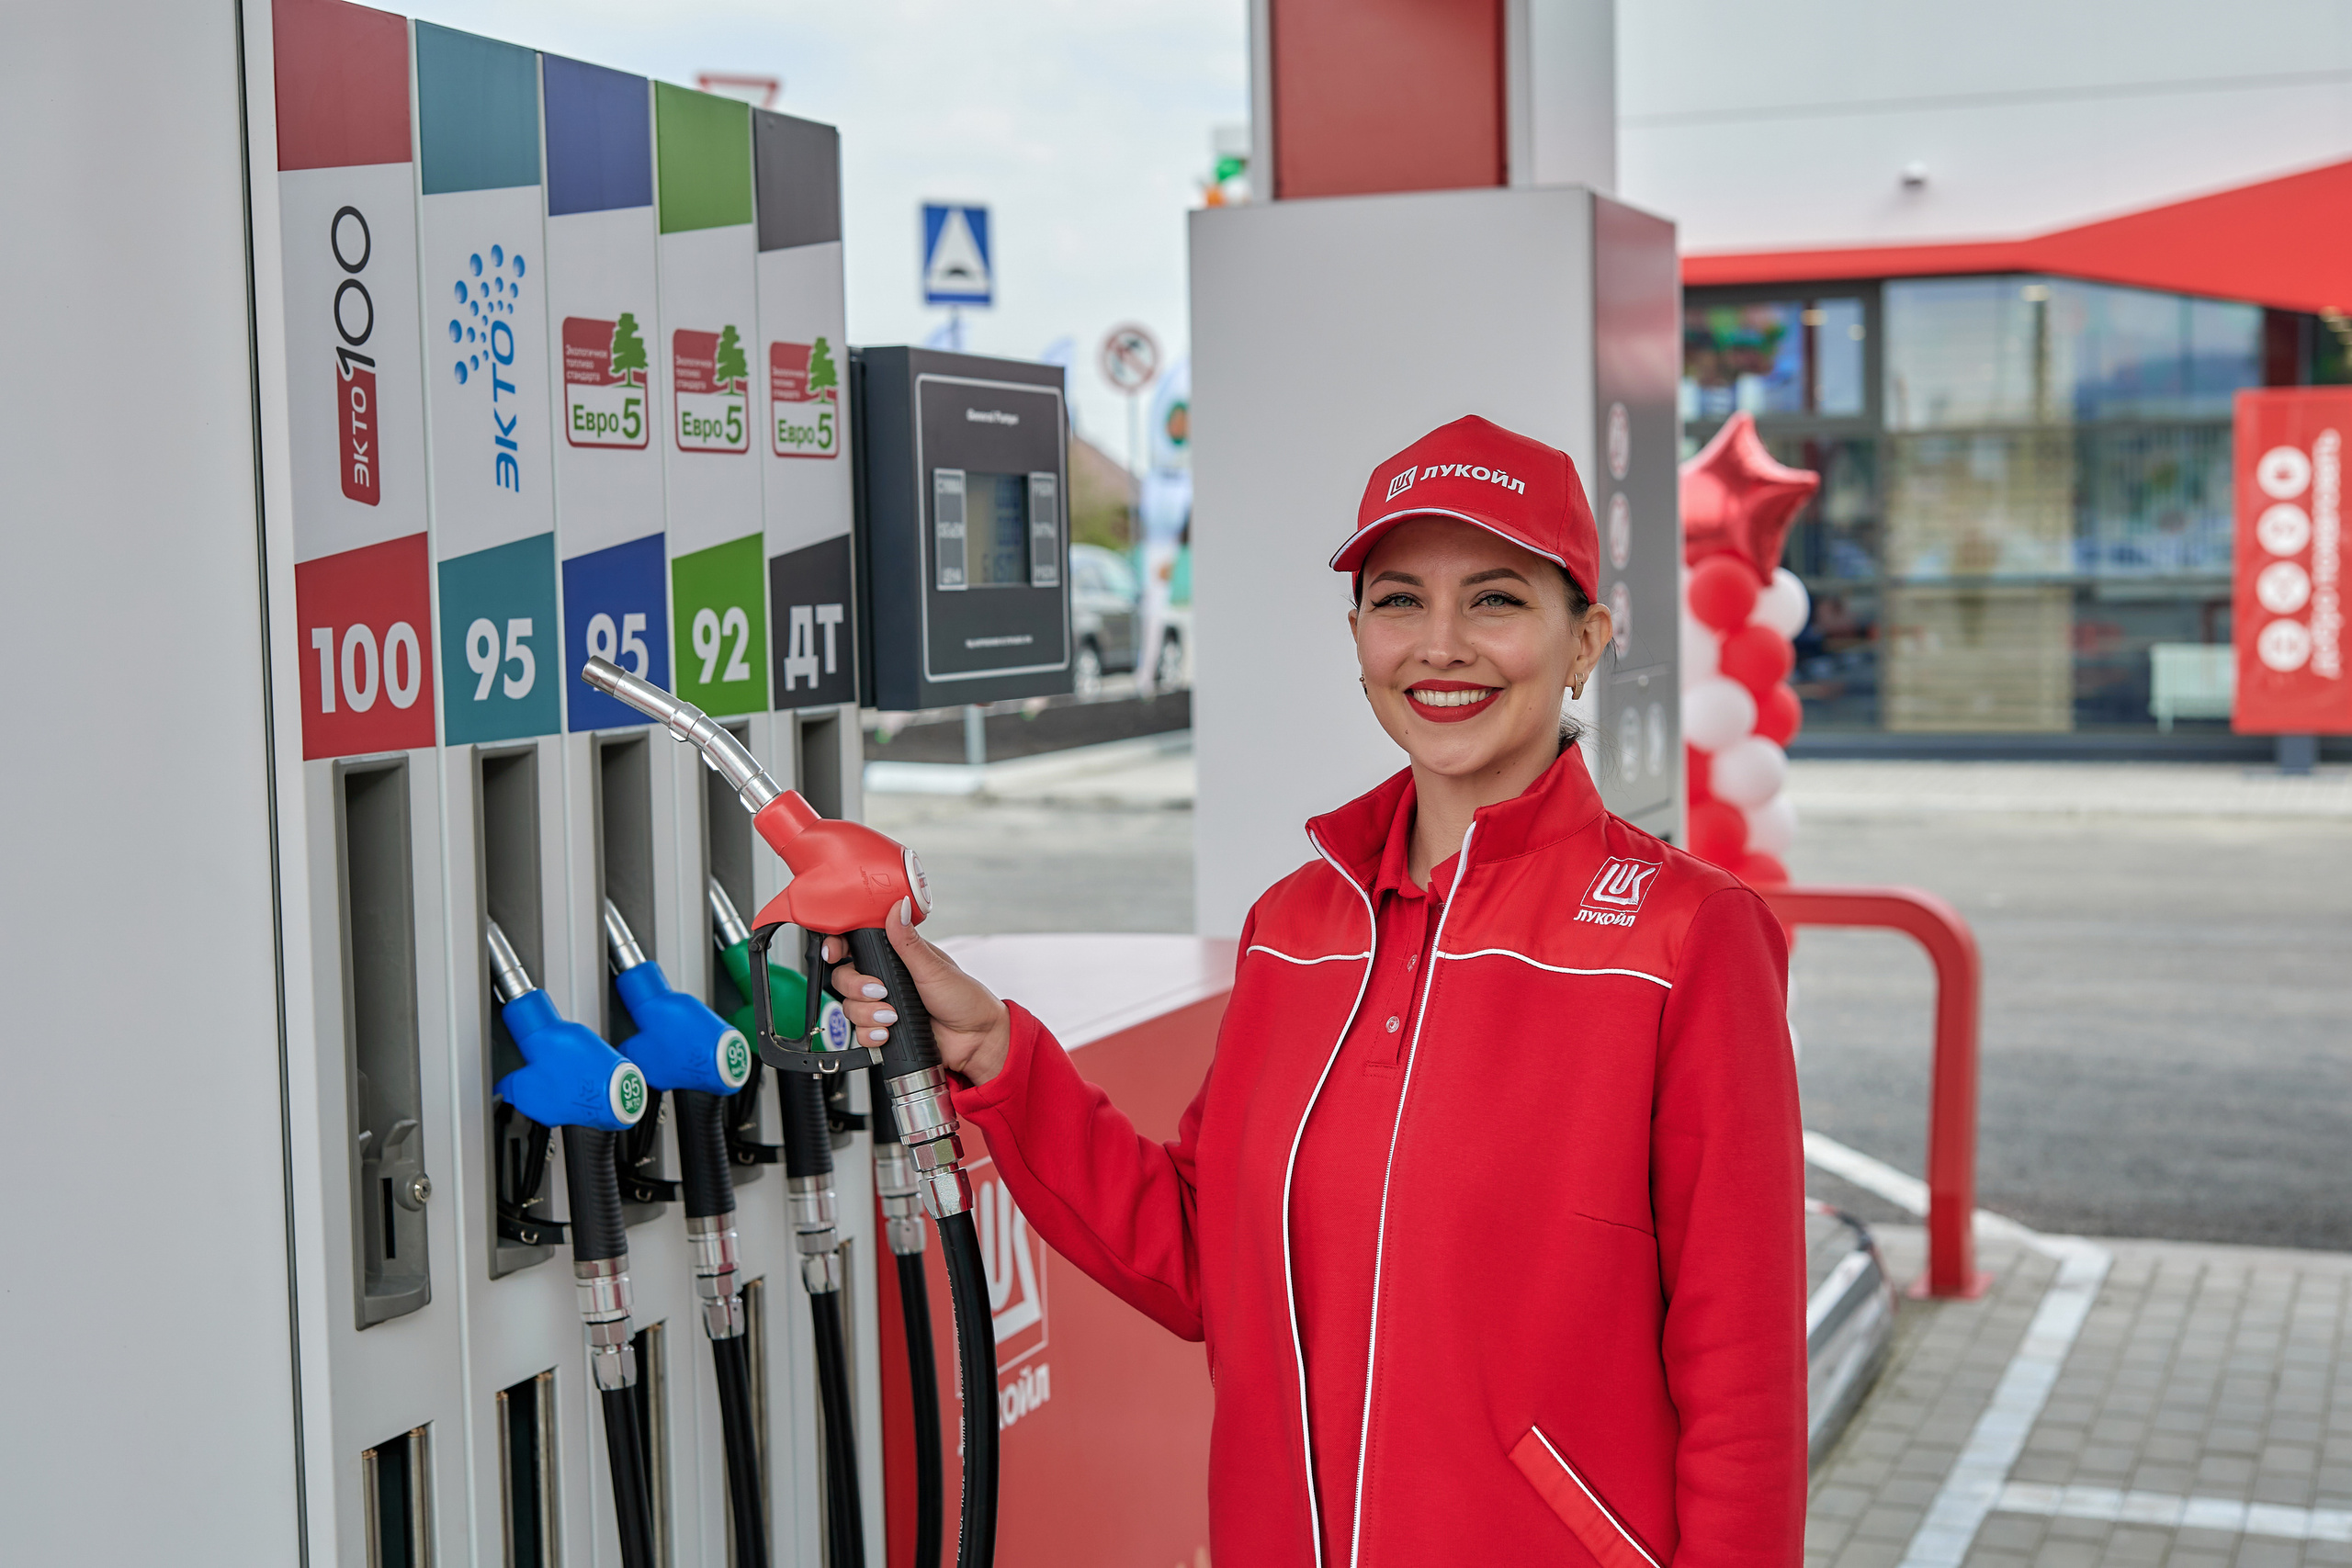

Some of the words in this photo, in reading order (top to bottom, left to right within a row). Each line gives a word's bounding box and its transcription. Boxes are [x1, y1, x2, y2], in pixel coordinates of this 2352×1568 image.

[331, 205, 376, 377] 100
[351, 386, 369, 488] ЭКТО
[491, 320, 519, 493] ЭКТО
[572, 404, 619, 438] Евро
[622, 398, 641, 439] 5
[682, 412, 722, 443] Евро
[726, 405, 742, 444] 5
[777, 419, 815, 448] Евро
[817, 412, 833, 449] 5
[1419, 463, 1526, 495] ЛУКОЙЛ
[311, 621, 422, 714] 100
[465, 617, 537, 701] 95
[585, 612, 650, 692] 95
[692, 606, 751, 684] 92
[784, 604, 844, 692] ДТ
[1573, 908, 1636, 928] ЛУКОЙЛ
[622, 1077, 640, 1100] 95
[728, 1043, 745, 1065] 95
